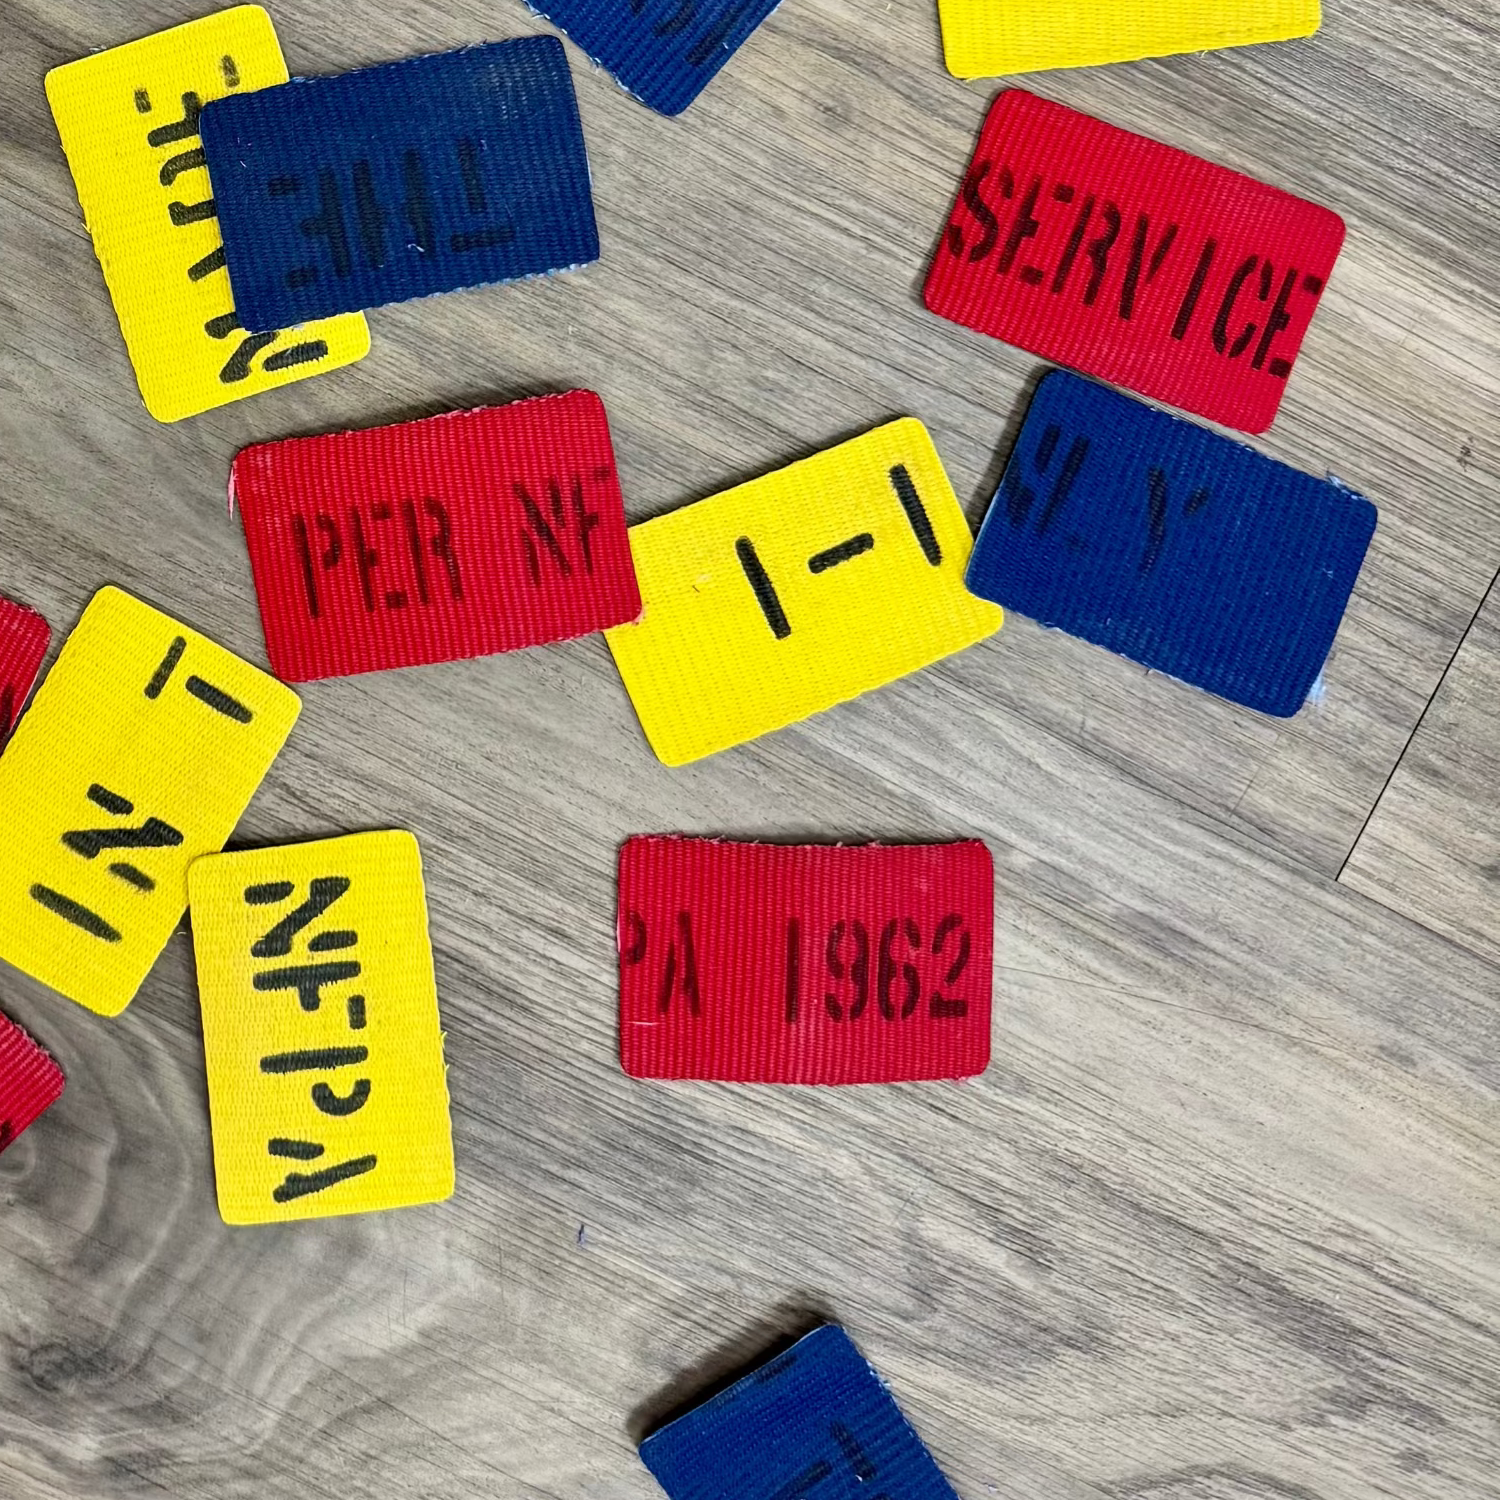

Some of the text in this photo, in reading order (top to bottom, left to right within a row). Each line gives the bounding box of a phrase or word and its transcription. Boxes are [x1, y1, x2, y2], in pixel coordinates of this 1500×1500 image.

[269, 138, 515, 291] THE
[947, 159, 1323, 378] SERVICE
[293, 464, 612, 619] PER NF
[29, 636, 254, 943] IN T
[243, 876, 378, 1203] NFPA
[785, 913, 971, 1023] 1962
